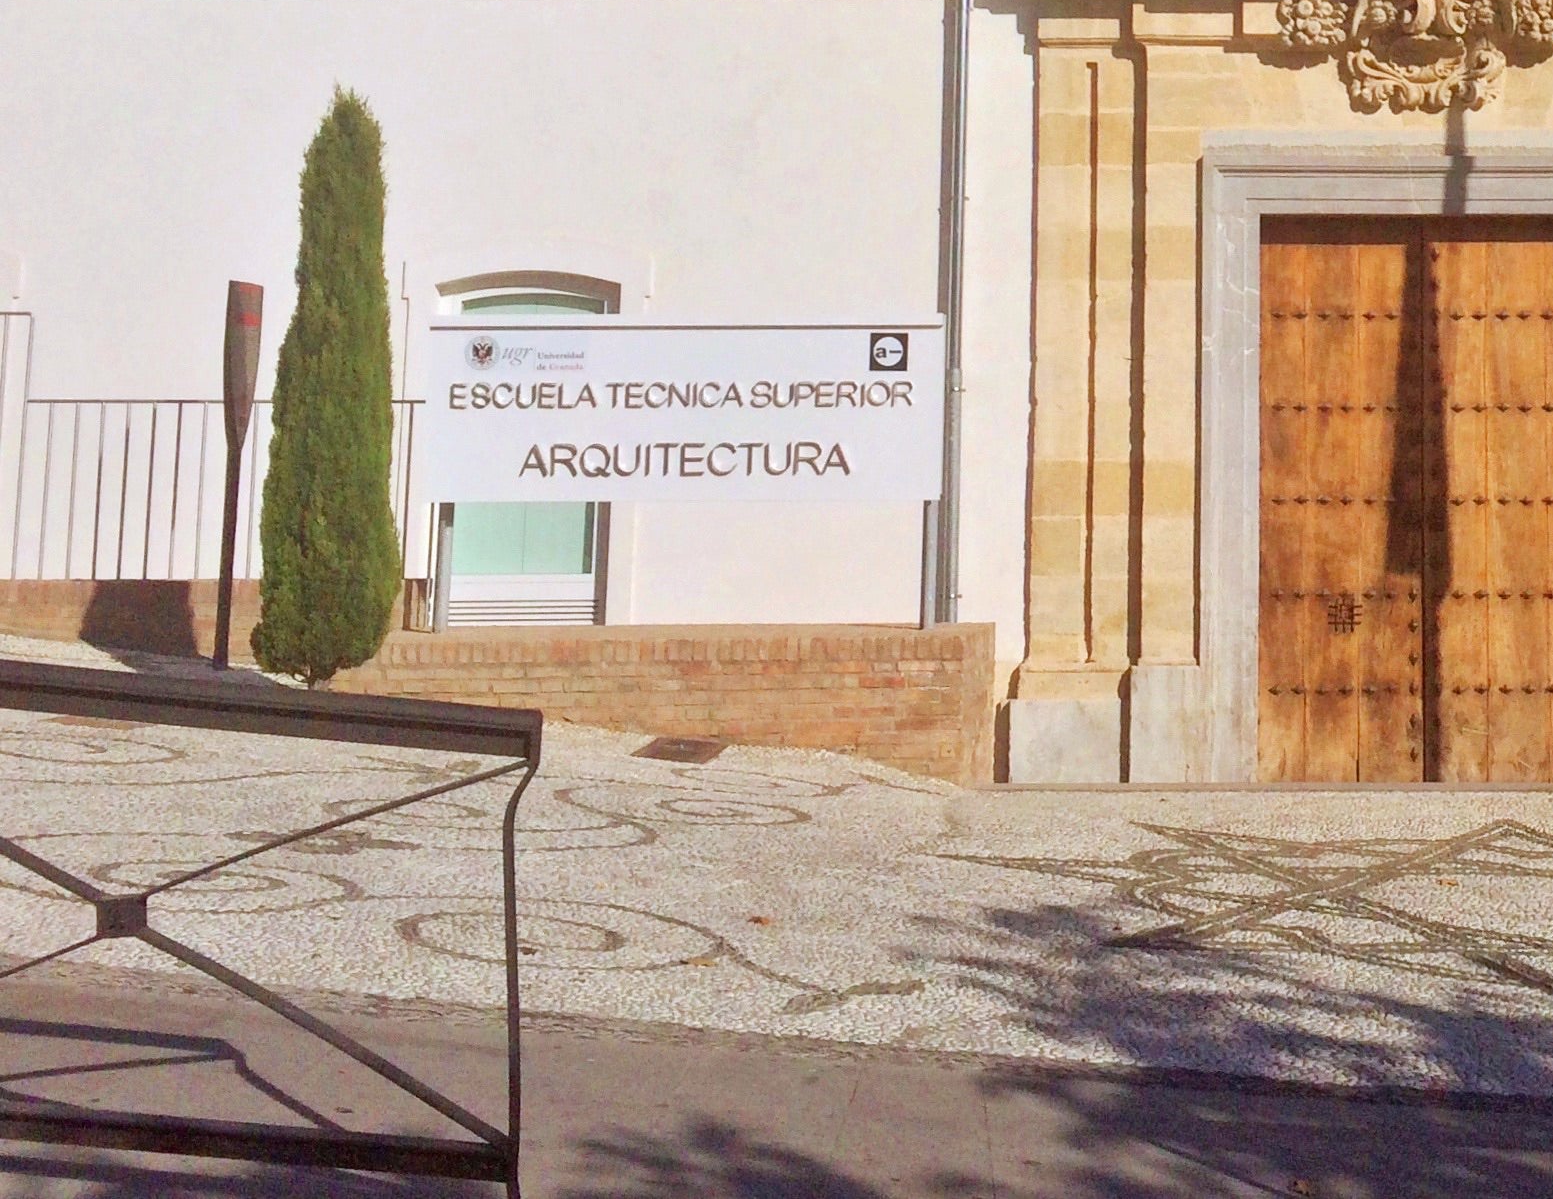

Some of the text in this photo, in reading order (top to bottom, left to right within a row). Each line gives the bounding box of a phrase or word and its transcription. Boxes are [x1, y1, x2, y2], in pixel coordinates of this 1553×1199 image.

[448, 379, 914, 410] ESCUELA TECNICA SUPERIOR
[518, 441, 851, 478] ARQUITECTURA
